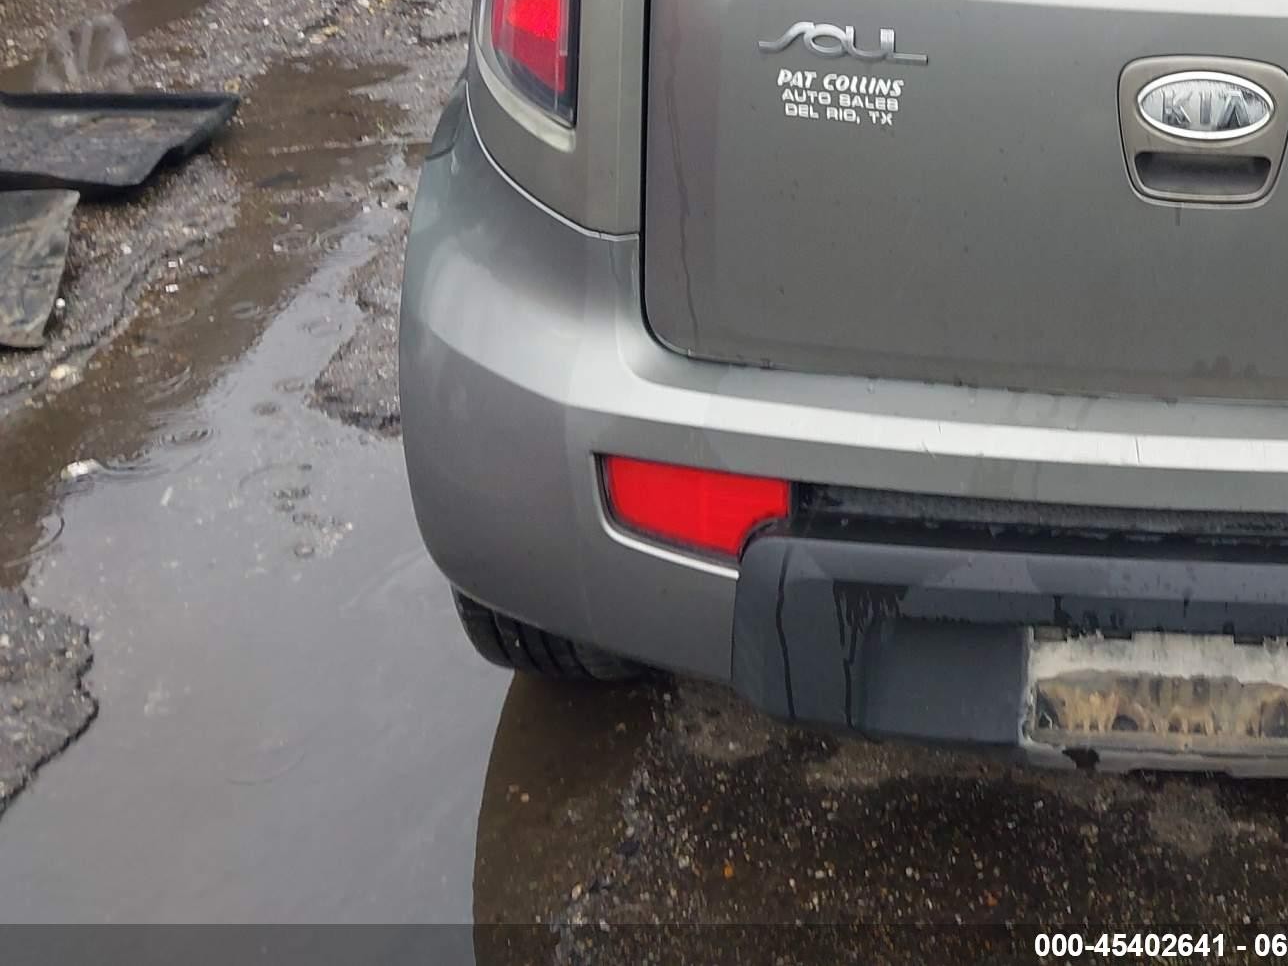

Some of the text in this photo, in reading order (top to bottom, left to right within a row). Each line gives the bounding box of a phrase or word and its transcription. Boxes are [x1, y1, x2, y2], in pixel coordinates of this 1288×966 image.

[758, 21, 929, 66] SOUL
[777, 68, 905, 97] PAT COLLINS
[781, 88, 899, 112] AUTO SALES
[785, 102, 893, 126] DEL RIO, TX
